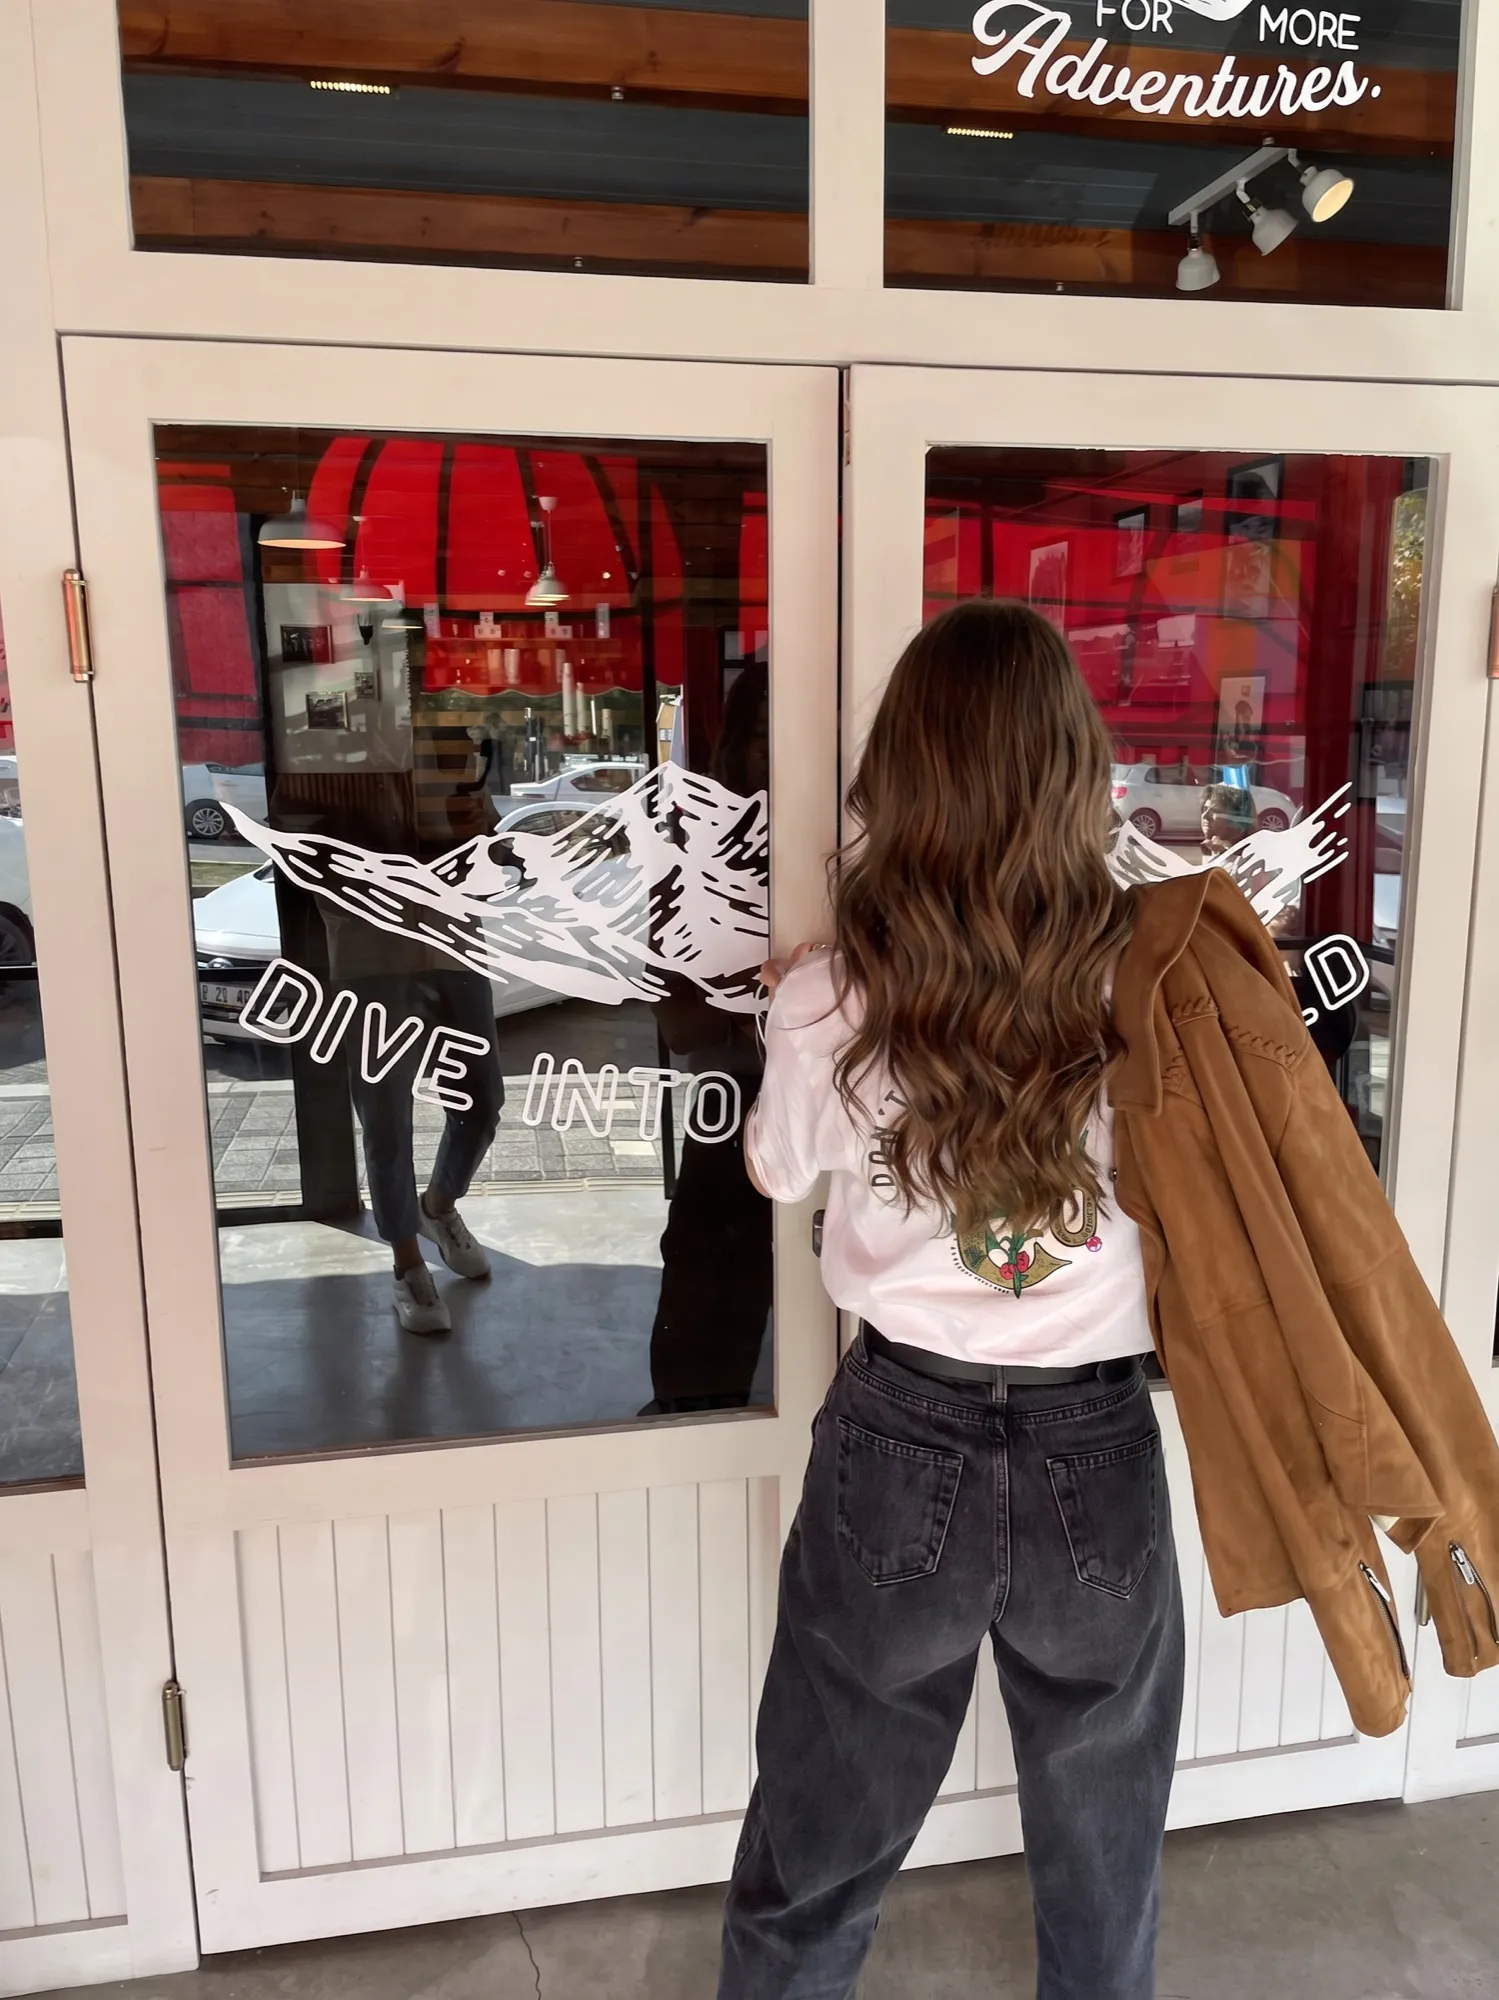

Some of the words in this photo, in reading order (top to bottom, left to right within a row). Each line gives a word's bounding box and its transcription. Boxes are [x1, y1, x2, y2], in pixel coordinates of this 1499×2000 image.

[971, 0, 1382, 118] Adventures.
[1096, 0, 1174, 34] FOR
[1258, 5, 1361, 50] MORE
[238, 957, 490, 1111] DIVE
[522, 1052, 742, 1144] INTO
